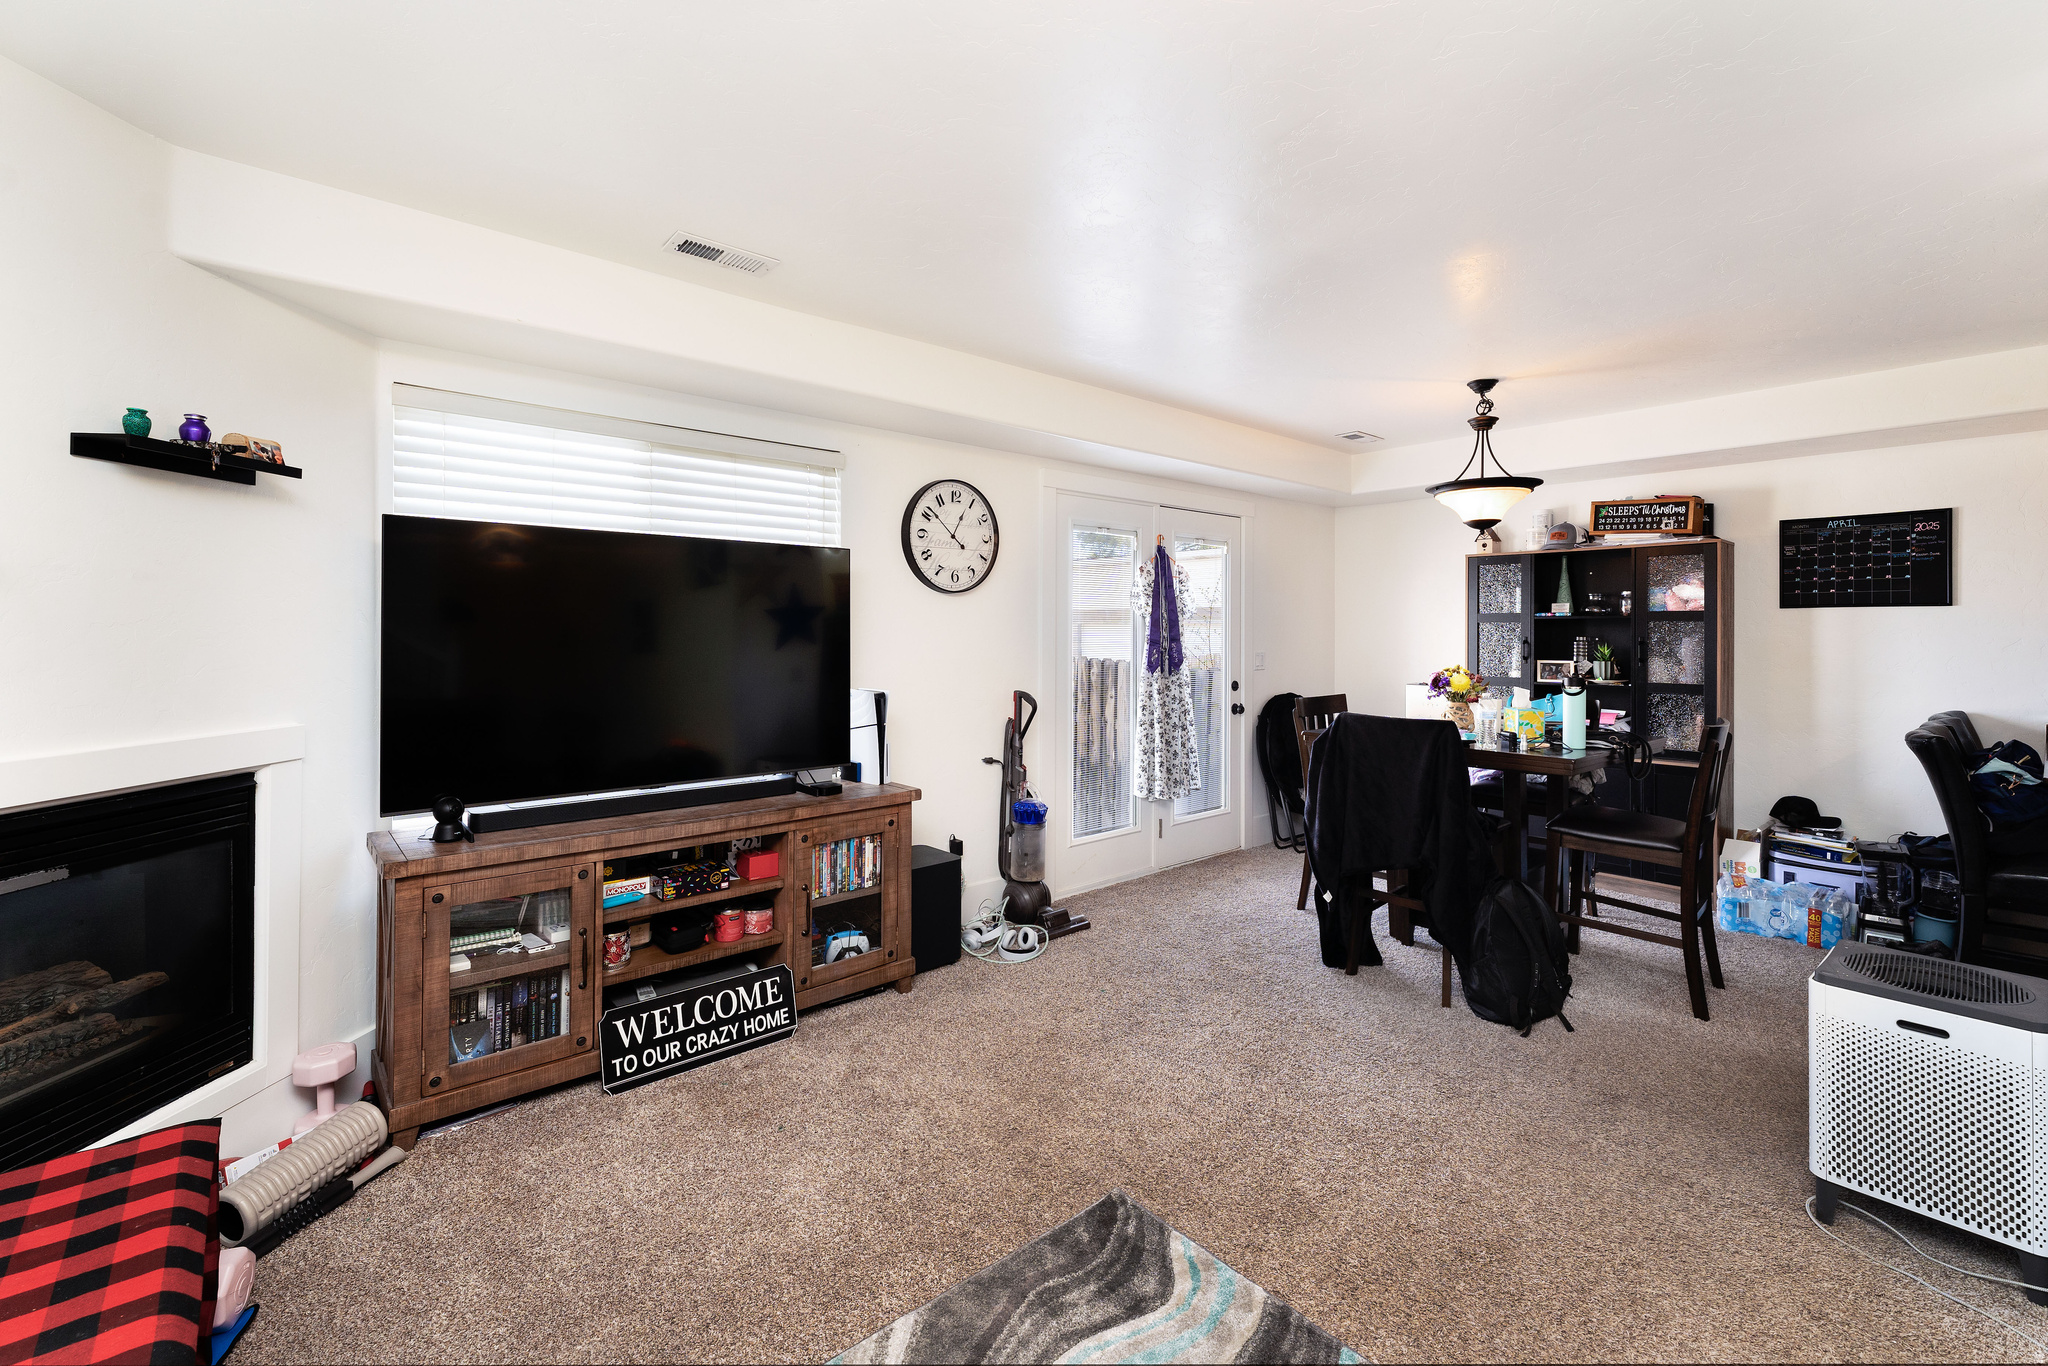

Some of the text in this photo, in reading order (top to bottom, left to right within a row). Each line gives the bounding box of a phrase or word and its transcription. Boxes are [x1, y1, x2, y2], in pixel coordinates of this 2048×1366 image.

[935, 493, 945, 507] 11
[951, 490, 961, 503] 12
[969, 498, 975, 509] 1
[922, 506, 935, 522] 10
[1608, 506, 1639, 516] SLEEPS
[1651, 504, 1686, 515] Christmas
[978, 514, 987, 525] 2
[1827, 519, 1860, 528] APRIL
[1914, 521, 1940, 532] 2025
[917, 528, 928, 539] 9
[921, 549, 932, 560] 8
[935, 565, 945, 576] 7
[951, 570, 959, 583] 6
[967, 565, 975, 579] 5
[607, 883, 646, 895] MONOPOLY
[612, 976, 783, 1048] WELCOME
[612, 1008, 790, 1077] TO OUR CRAZY HOME
